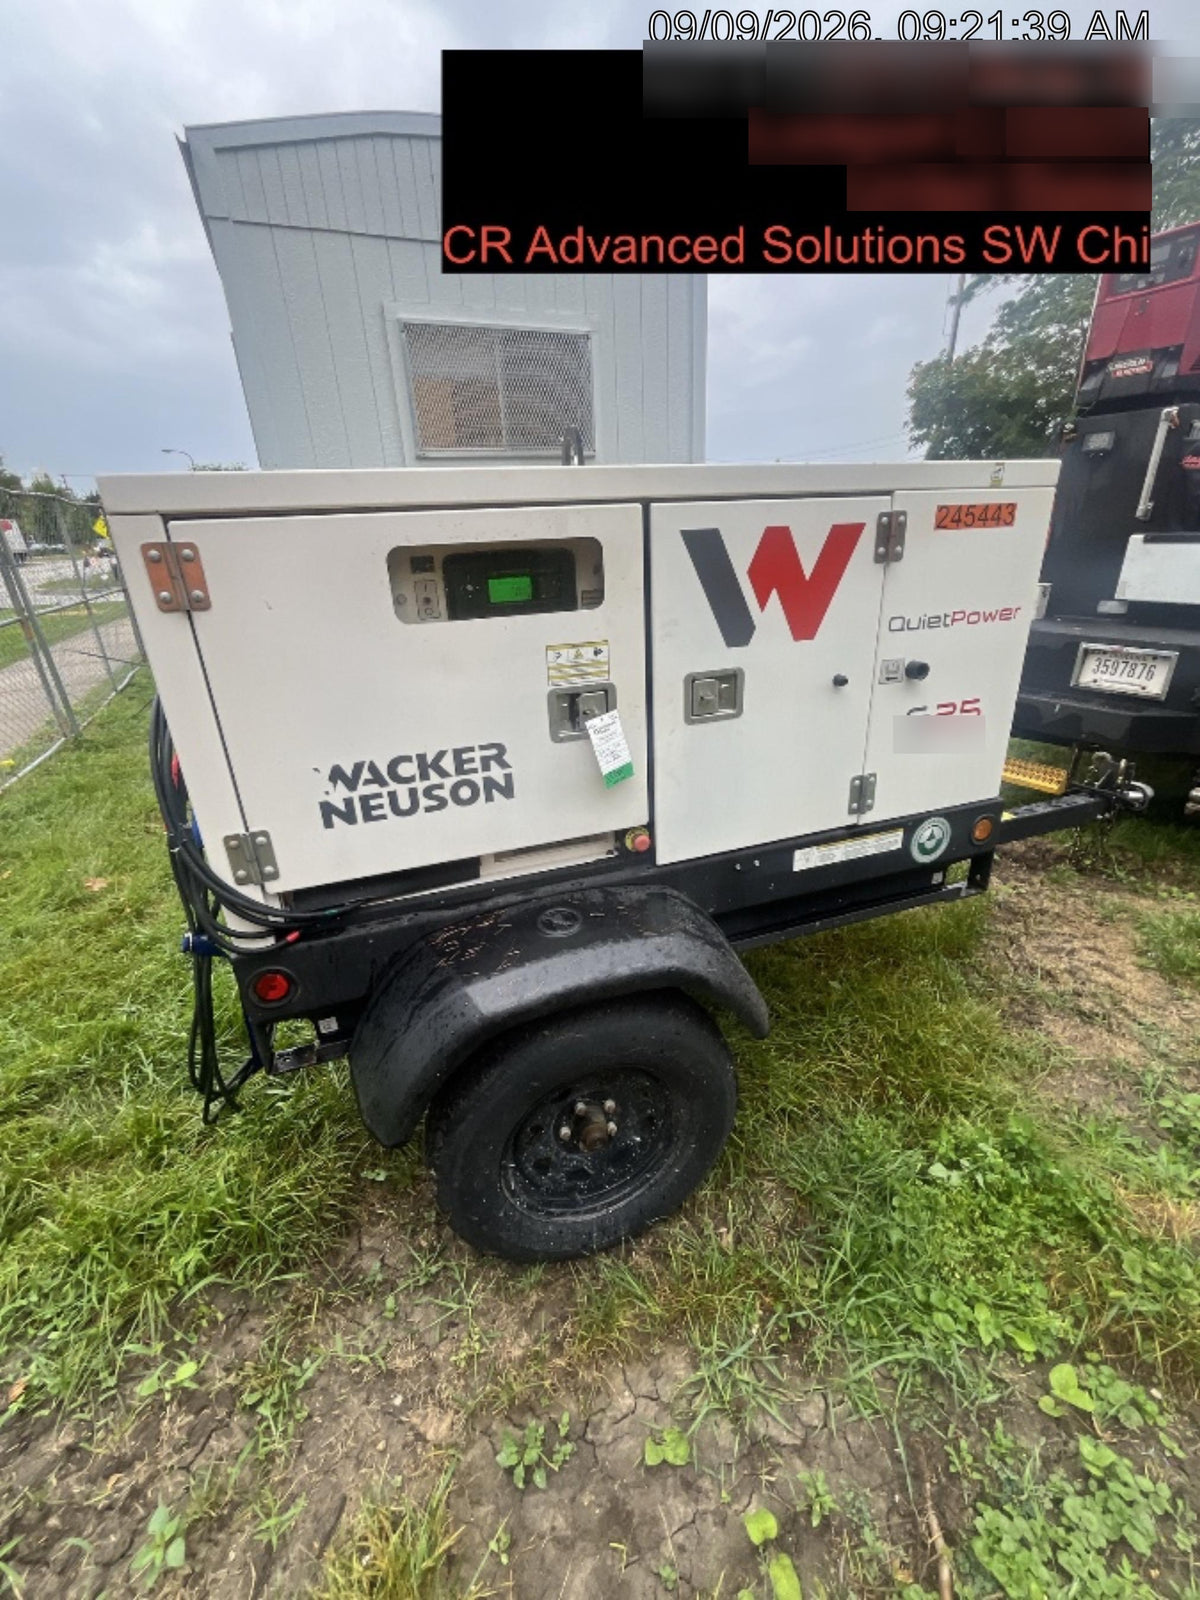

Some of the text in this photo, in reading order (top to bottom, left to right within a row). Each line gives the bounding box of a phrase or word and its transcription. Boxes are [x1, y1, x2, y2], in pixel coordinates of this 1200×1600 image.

[936, 502, 1017, 530] 245443
[888, 606, 1022, 633] QuietPower
[1092, 657, 1157, 682] 3597876
[312, 742, 512, 796] WACKER
[318, 772, 515, 829] NEUSON
